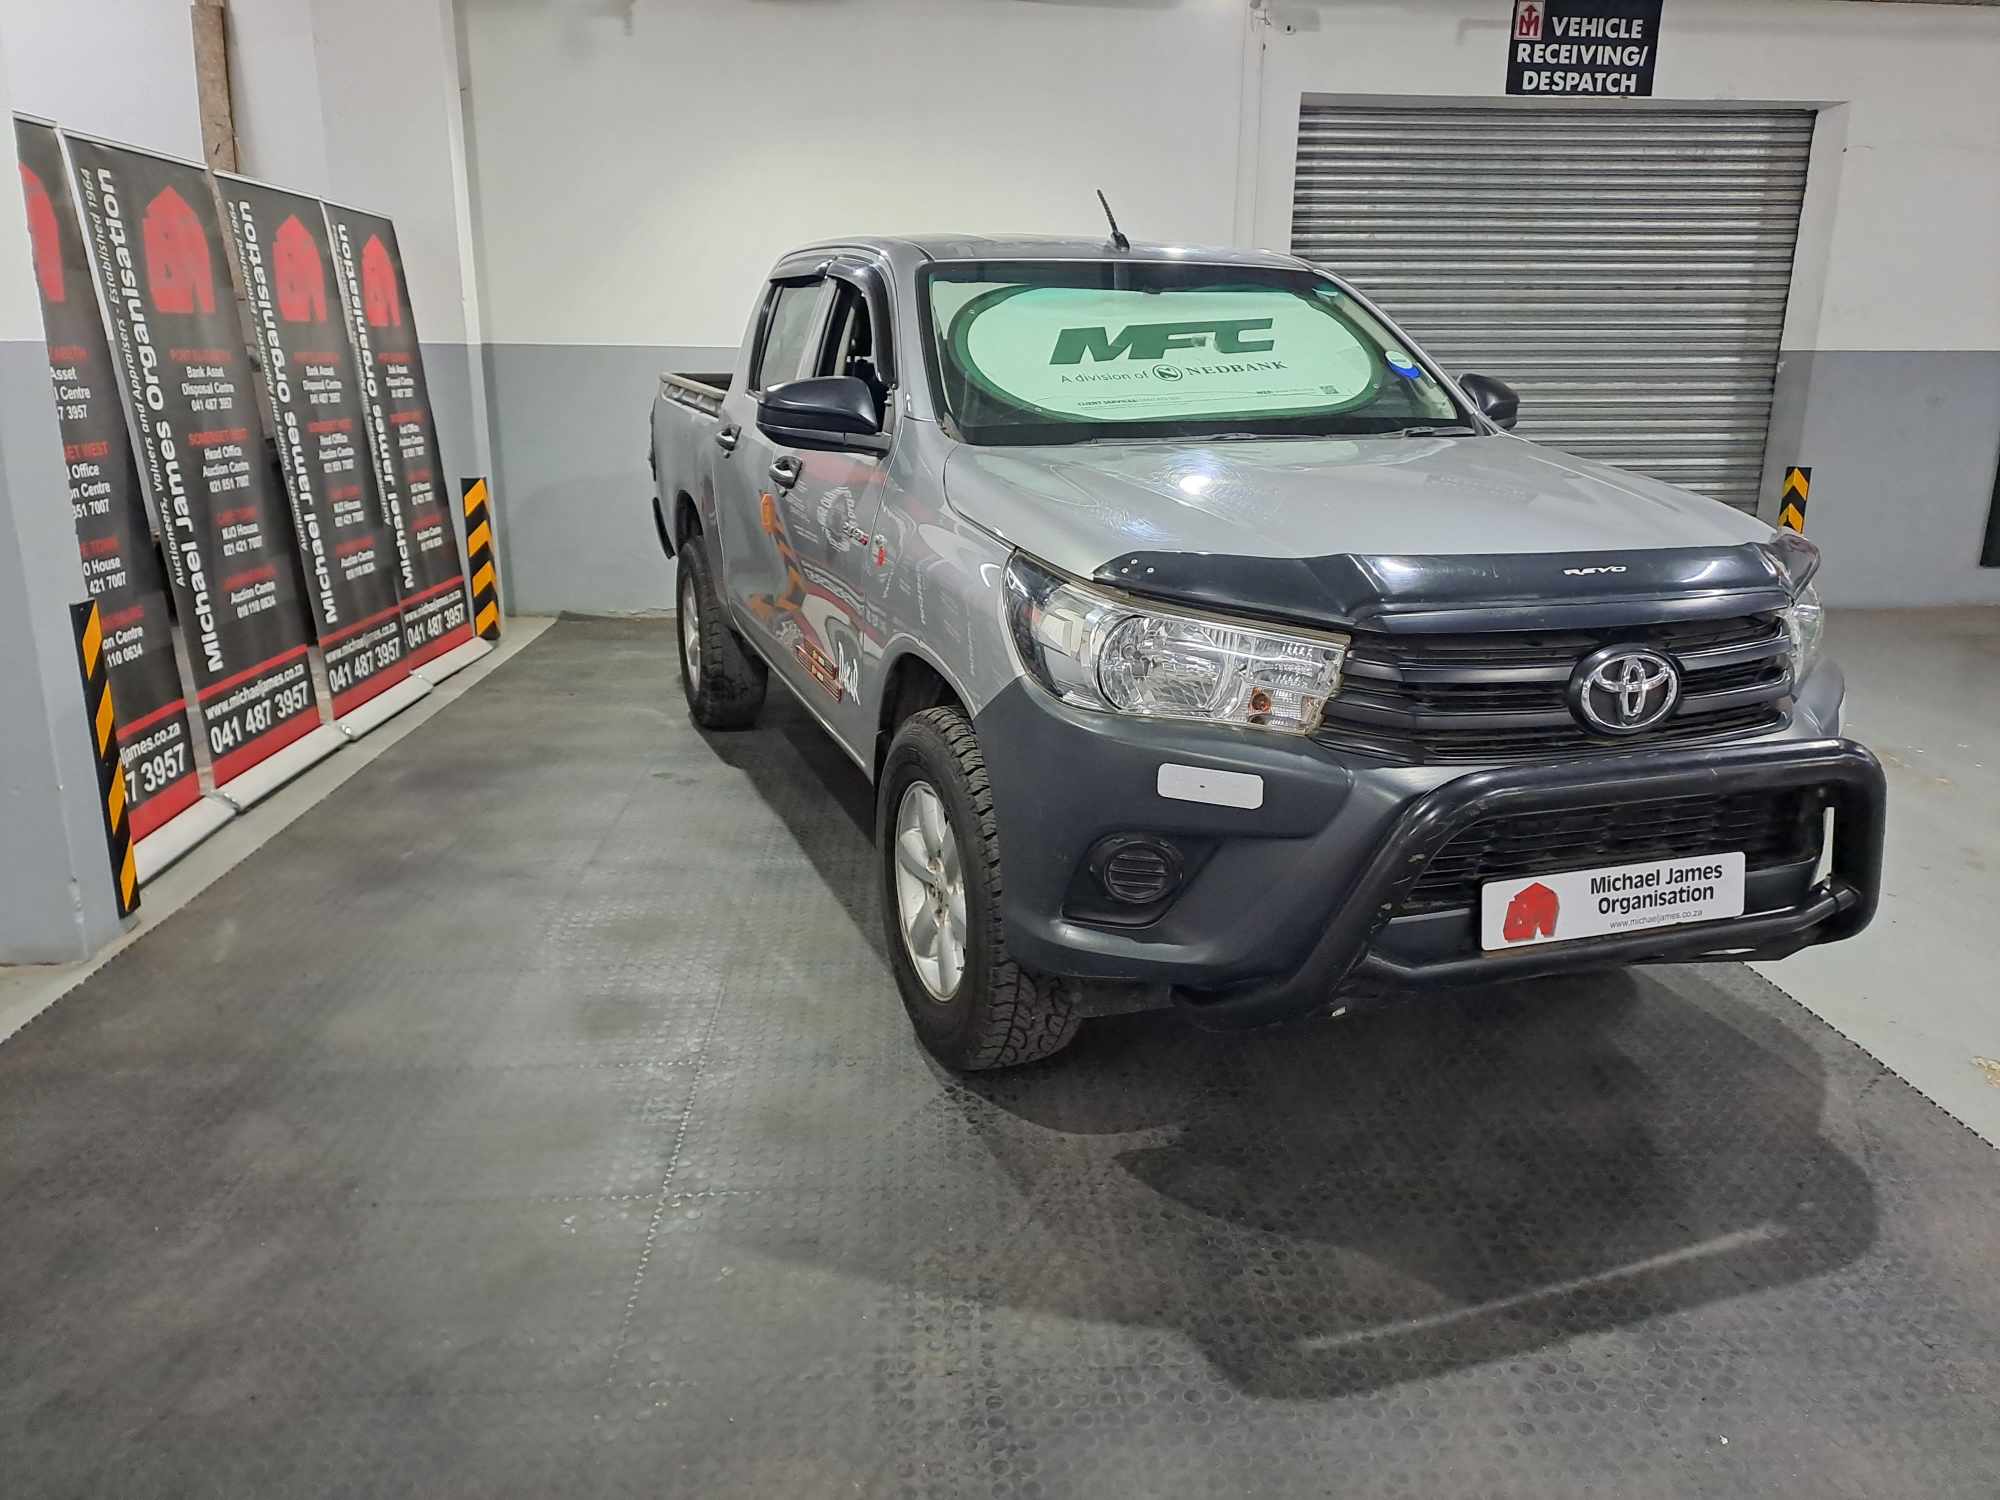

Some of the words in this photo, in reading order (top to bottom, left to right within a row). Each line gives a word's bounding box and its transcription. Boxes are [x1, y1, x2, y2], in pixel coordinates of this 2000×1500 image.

[1552, 16, 1643, 39] VEHICLE
[1517, 43, 1648, 67] RECEIVING/
[1522, 70, 1637, 93] DESPATCH
[80, 168, 98, 207] 1964
[89, 212, 119, 304] Established
[97, 168, 164, 411] Organisation
[239, 201, 291, 403] Organisation
[338, 224, 378, 397] Organisation
[116, 317, 142, 400] Appraisers
[1049, 317, 1275, 365] MFC
[60, 386, 91, 400] Centre
[1061, 375, 1071, 385] A
[1077, 369, 1131, 383] division
[1135, 370, 1149, 382] of
[1186, 359, 1288, 376] NEDBANK
[66, 404, 87, 420] 3957
[135, 402, 150, 433] and
[145, 436, 163, 491] Valuers
[284, 411, 313, 505] James
[372, 404, 395, 486] James
[72, 463, 99, 478] Office
[81, 482, 111, 497] Centre
[156, 421, 193, 532] James
[387, 492, 415, 589] Michael
[91, 557, 121, 574] House
[303, 513, 338, 624] Michael
[181, 542, 224, 672] Michael
[407, 622, 426, 648] 041
[427, 614, 442, 637] 487
[444, 602, 464, 629] 3957
[329, 662, 353, 692] 041
[354, 650, 374, 678] 487
[375, 636, 400, 668] 3957
[210, 716, 242, 754] 041
[245, 700, 271, 734] 487
[274, 681, 308, 718] 3957
[141, 742, 184, 792] 3957
[1590, 869, 1660, 895] Michael
[1665, 864, 1723, 886] James
[1598, 884, 1715, 915] Organisation
